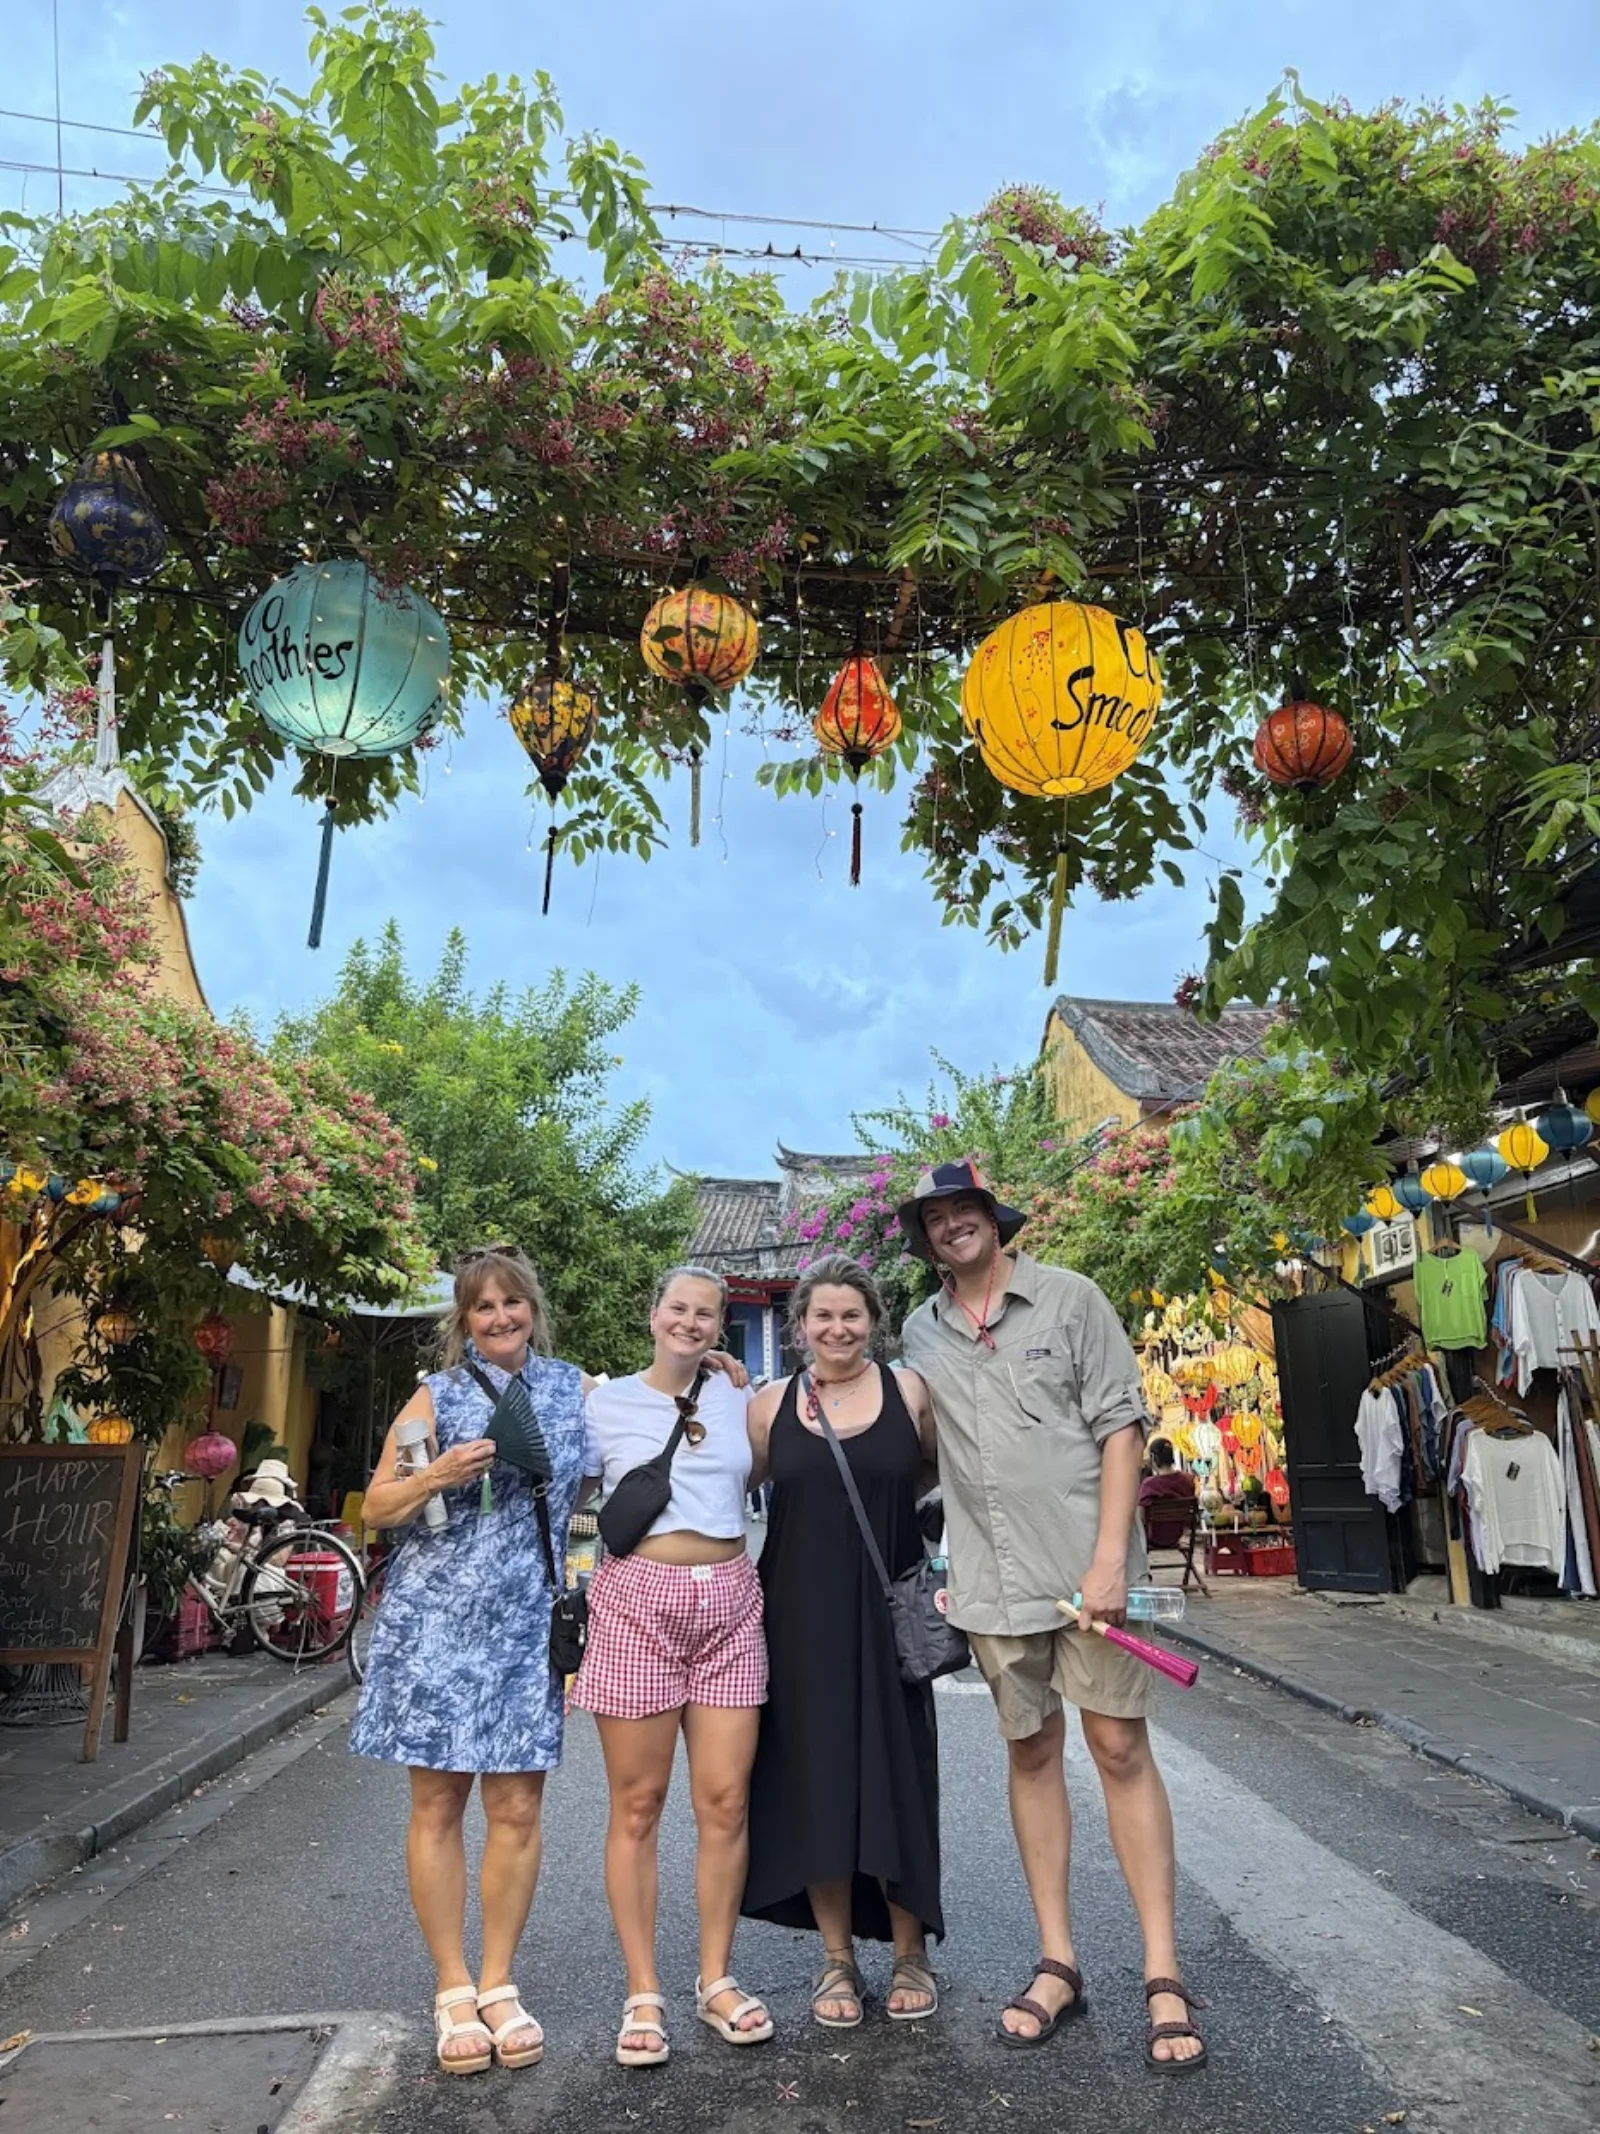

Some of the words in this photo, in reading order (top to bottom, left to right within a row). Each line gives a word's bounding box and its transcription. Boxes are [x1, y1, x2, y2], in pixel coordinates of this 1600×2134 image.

[4, 1461, 110, 1499] HAPPY
[1, 1500, 112, 1545] HOUR
[36, 1545, 59, 1575] 2
